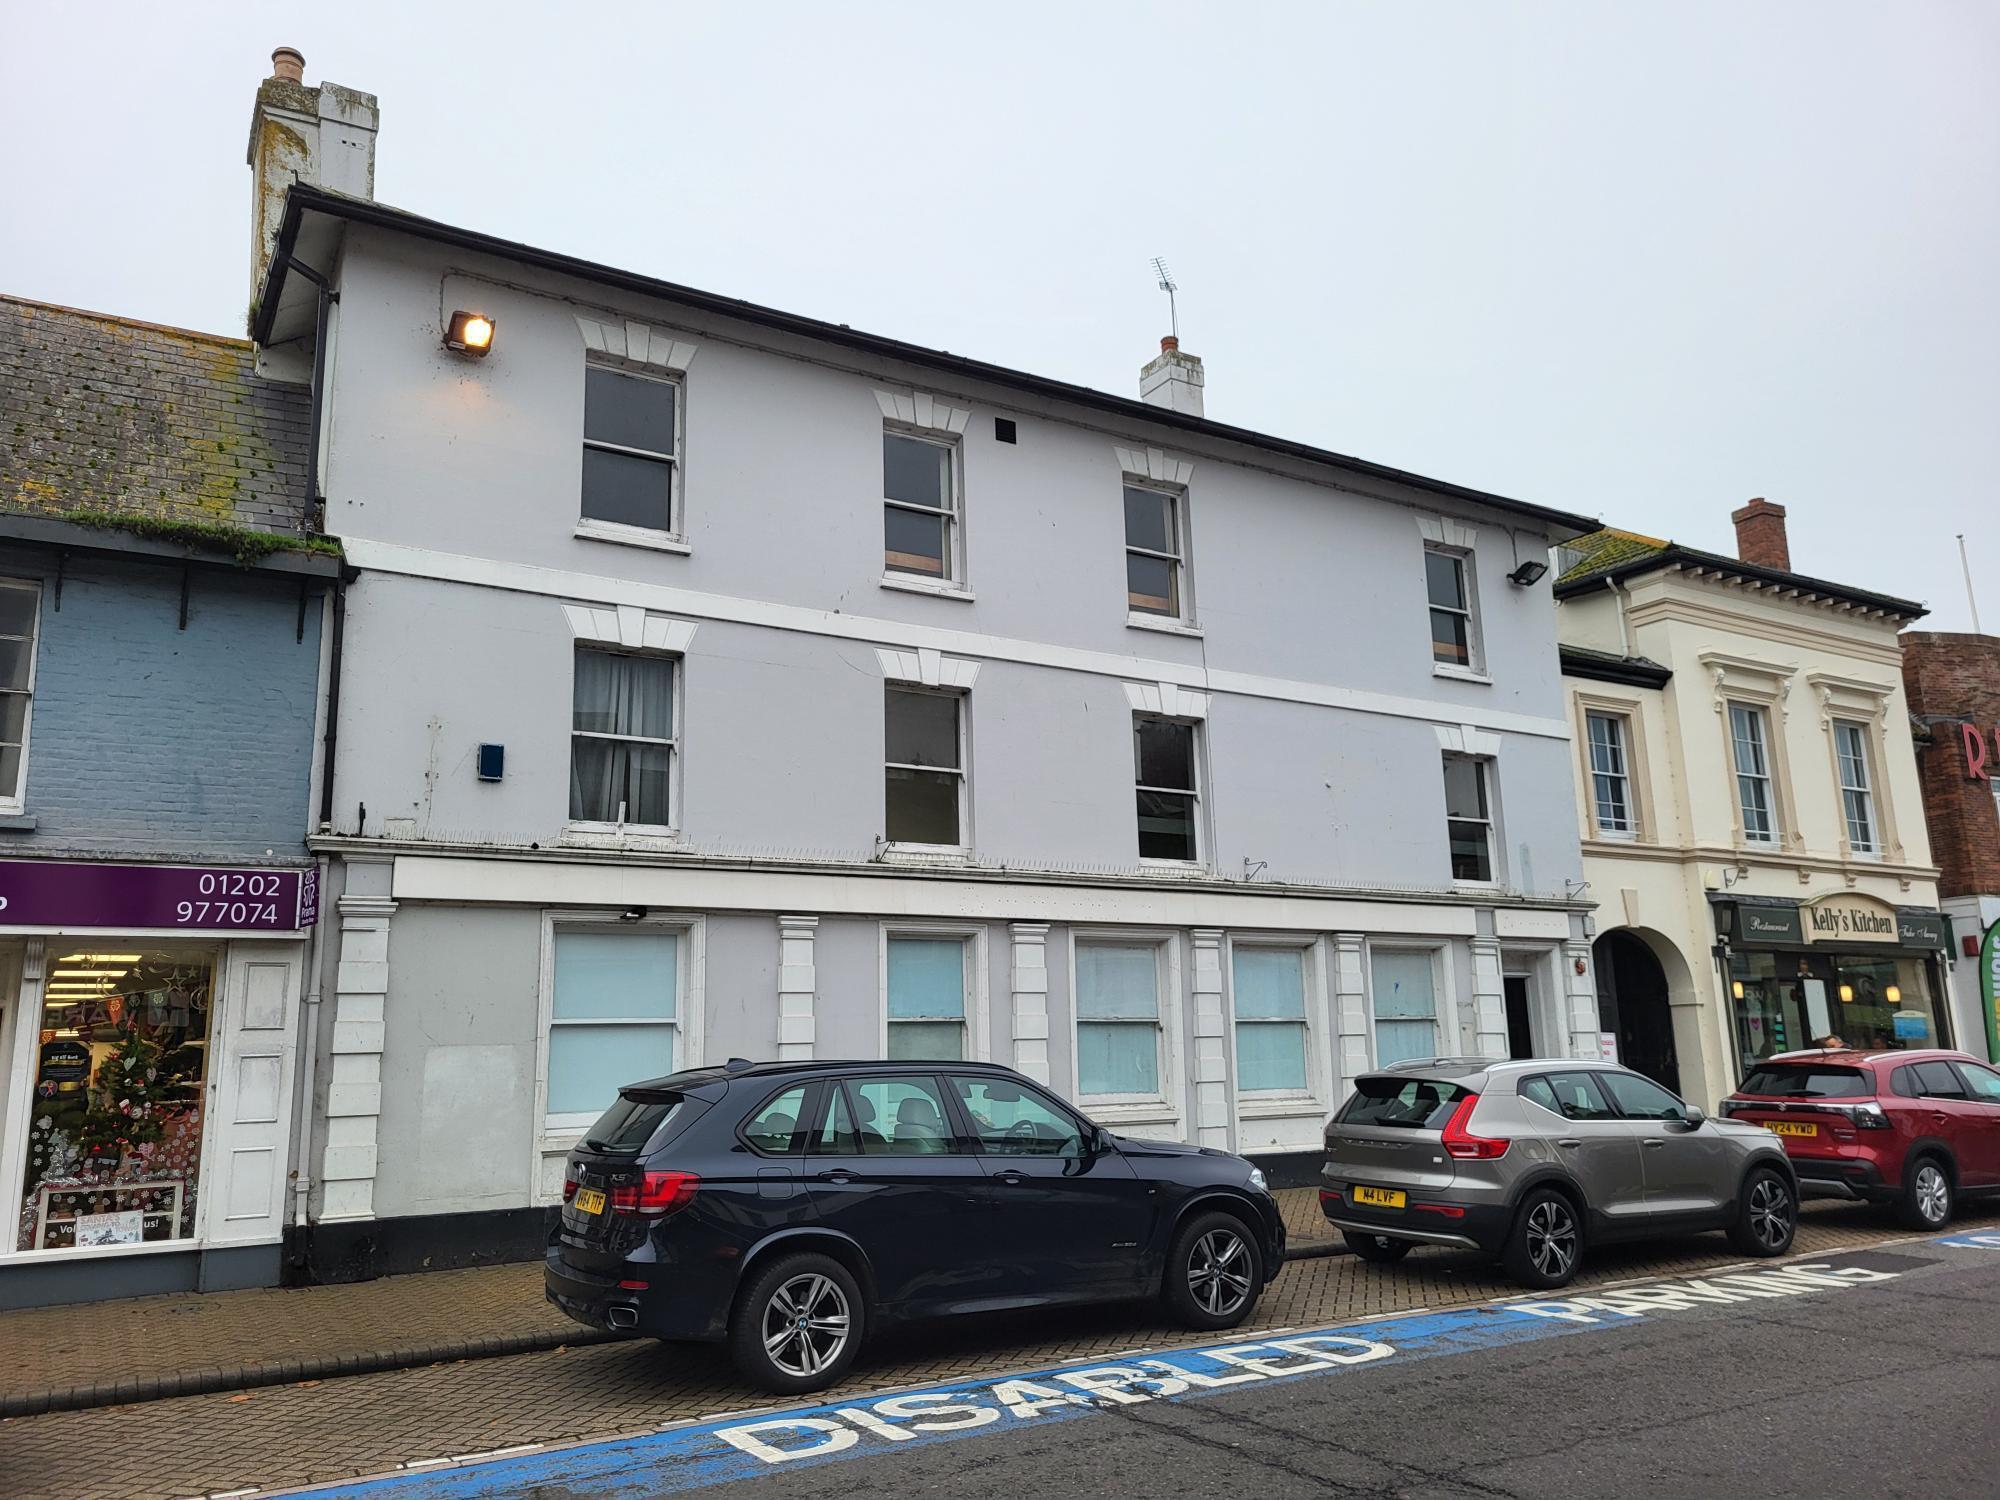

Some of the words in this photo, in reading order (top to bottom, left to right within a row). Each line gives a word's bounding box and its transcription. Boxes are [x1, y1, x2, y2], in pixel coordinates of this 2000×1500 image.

[200, 873, 281, 897] 01202
[176, 901, 278, 924] 977074
[1750, 916, 1790, 932] Restaurant
[1811, 906, 1849, 938] Kelly's
[1852, 907, 1893, 934] Kitchen
[1363, 1188, 1375, 1200] N4
[1376, 1190, 1396, 1203] LVF
[60, 1223, 76, 1234] Vol
[143, 1218, 159, 1229] us!
[712, 1336, 1397, 1464] DISABLED
[1504, 1263, 1902, 1323] PARKING
